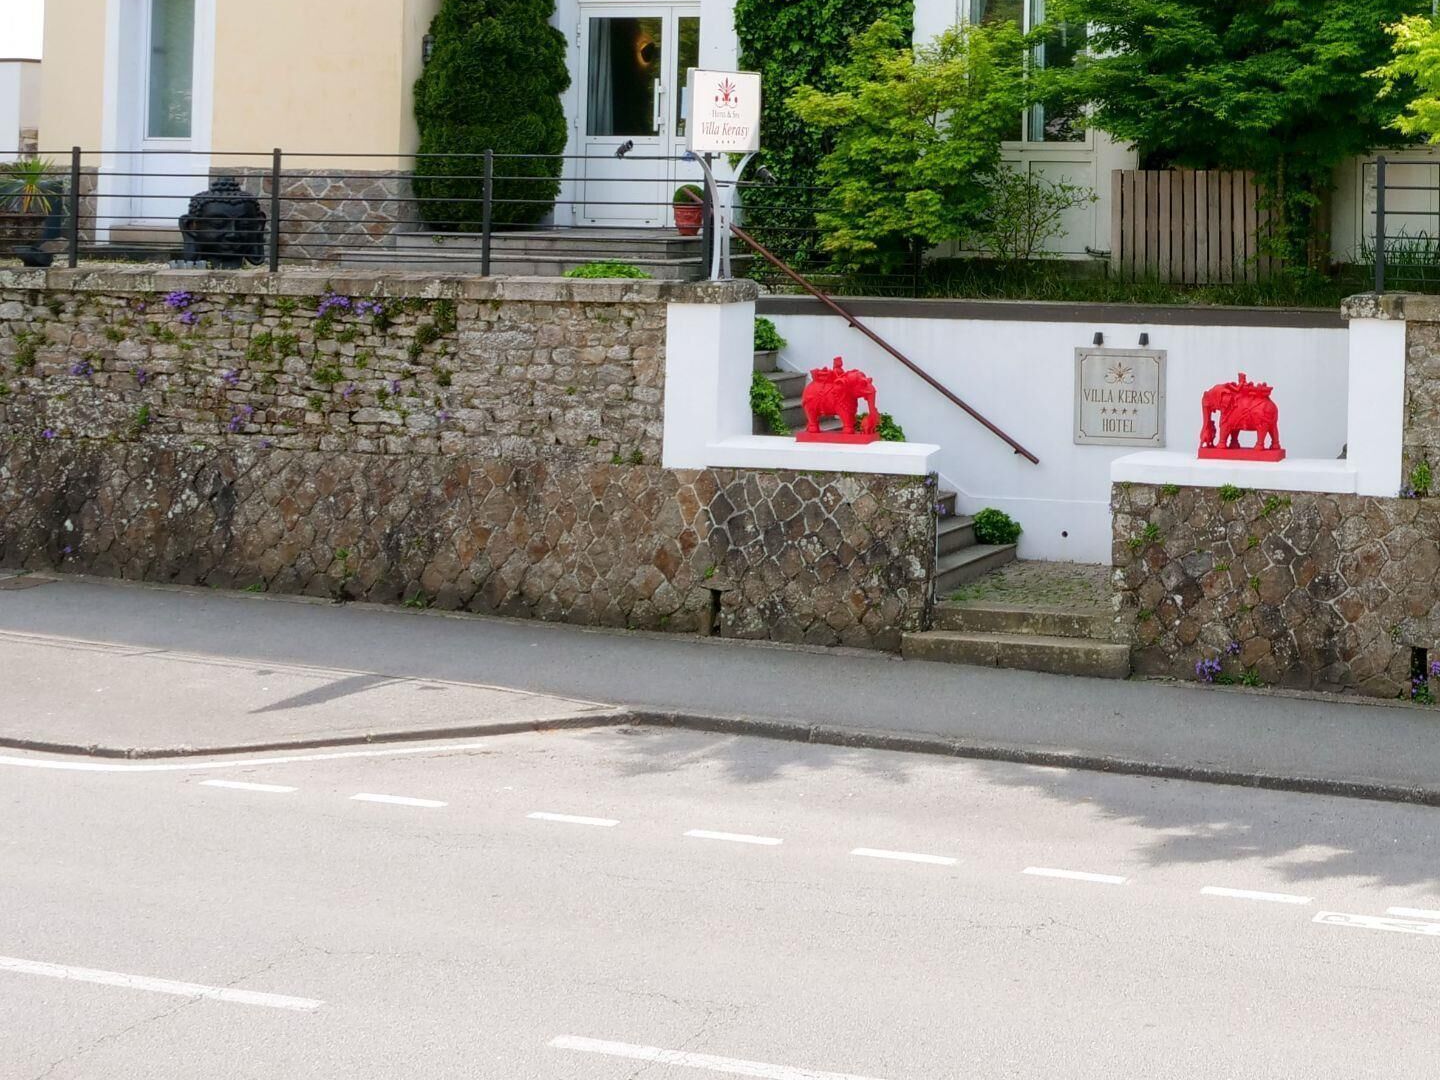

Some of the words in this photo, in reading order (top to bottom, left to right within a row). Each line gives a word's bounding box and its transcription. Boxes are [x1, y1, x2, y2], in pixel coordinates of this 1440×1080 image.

[702, 121, 720, 136] Villa
[722, 122, 750, 139] Kerasy
[1083, 388, 1114, 403] VILLA
[1118, 389, 1157, 405] KERASY
[1102, 418, 1136, 433] HOTEL
